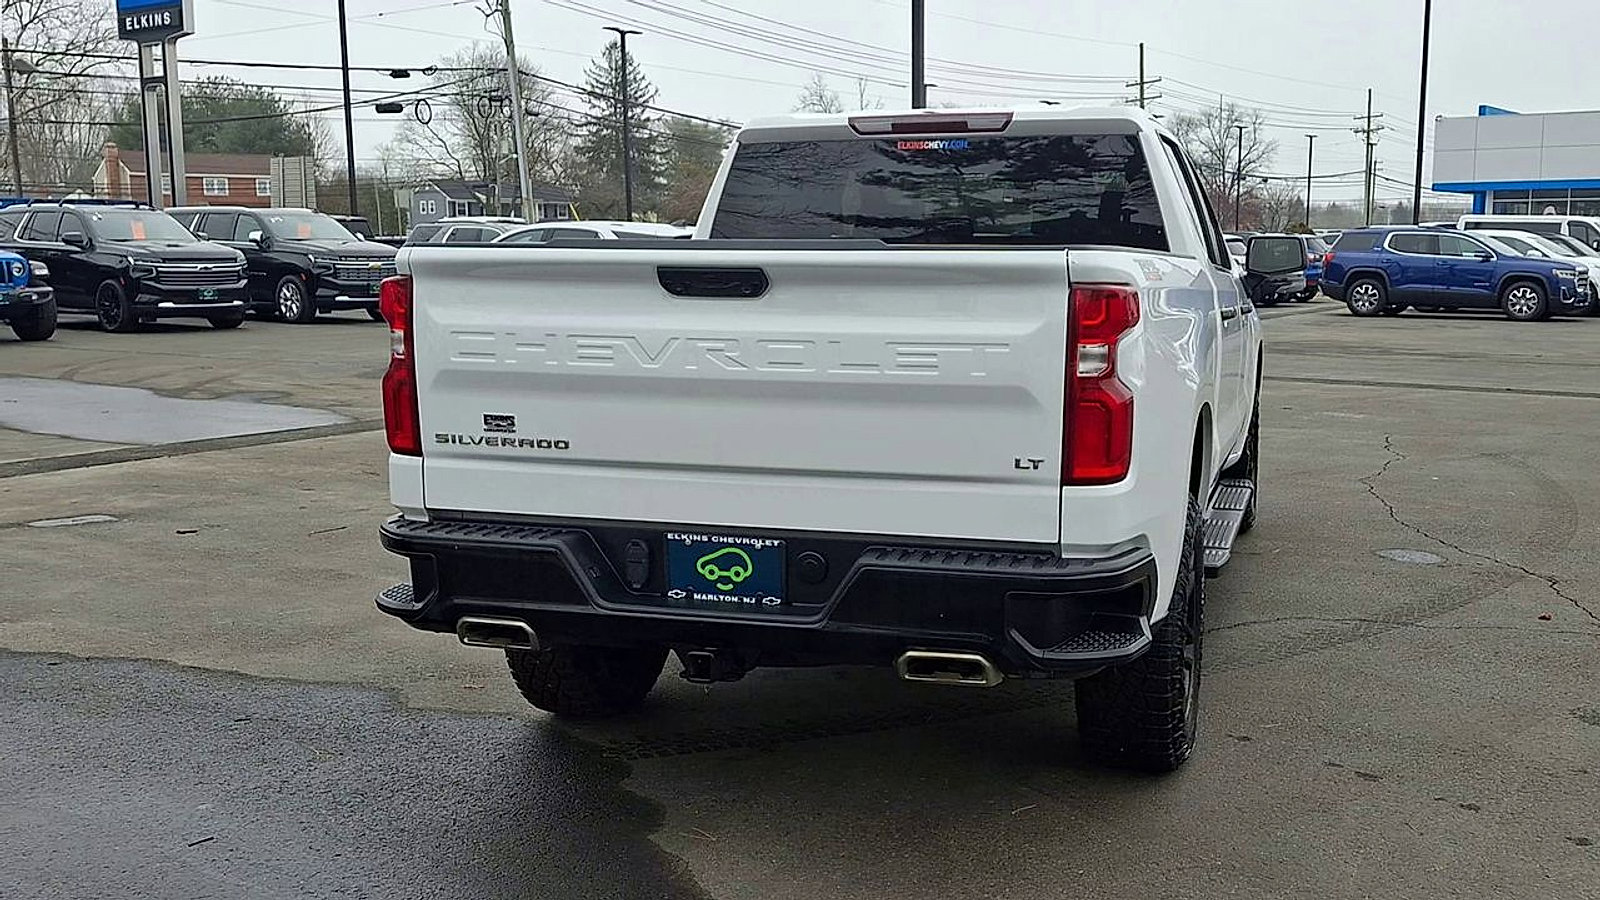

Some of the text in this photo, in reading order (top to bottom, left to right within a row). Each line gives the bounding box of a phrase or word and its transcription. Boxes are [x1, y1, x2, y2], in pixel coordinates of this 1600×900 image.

[126, 11, 171, 31] ELKINS
[450, 330, 1011, 376] CHEVROLET
[434, 433, 570, 450] SILVERADO
[1014, 458, 1045, 470] LT
[667, 533, 781, 547] ELKINS CHEVROLET
[743, 596, 756, 604] NJ
